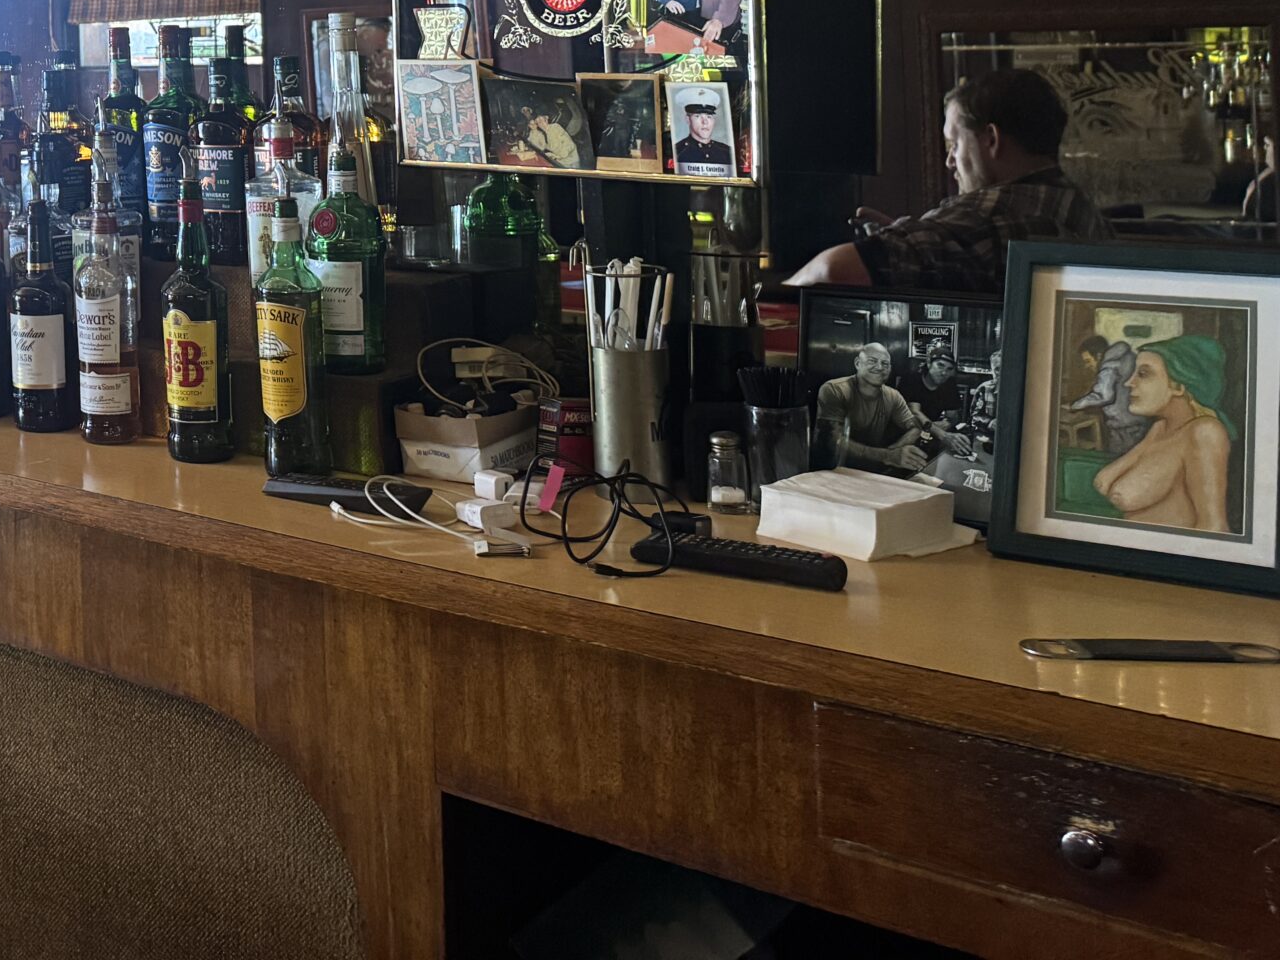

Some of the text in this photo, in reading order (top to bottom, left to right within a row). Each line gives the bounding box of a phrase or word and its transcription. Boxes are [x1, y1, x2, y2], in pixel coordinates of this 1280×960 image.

[540, 10, 592, 27] BEER
[248, 201, 274, 213] BEEFEA
[77, 312, 115, 325] Dewar's
[270, 309, 300, 326] SARK
[10, 325, 45, 338] Canadian
[91, 331, 112, 340] Label
[918, 327, 949, 336] YUENGLING
[165, 338, 204, 388] J&B
